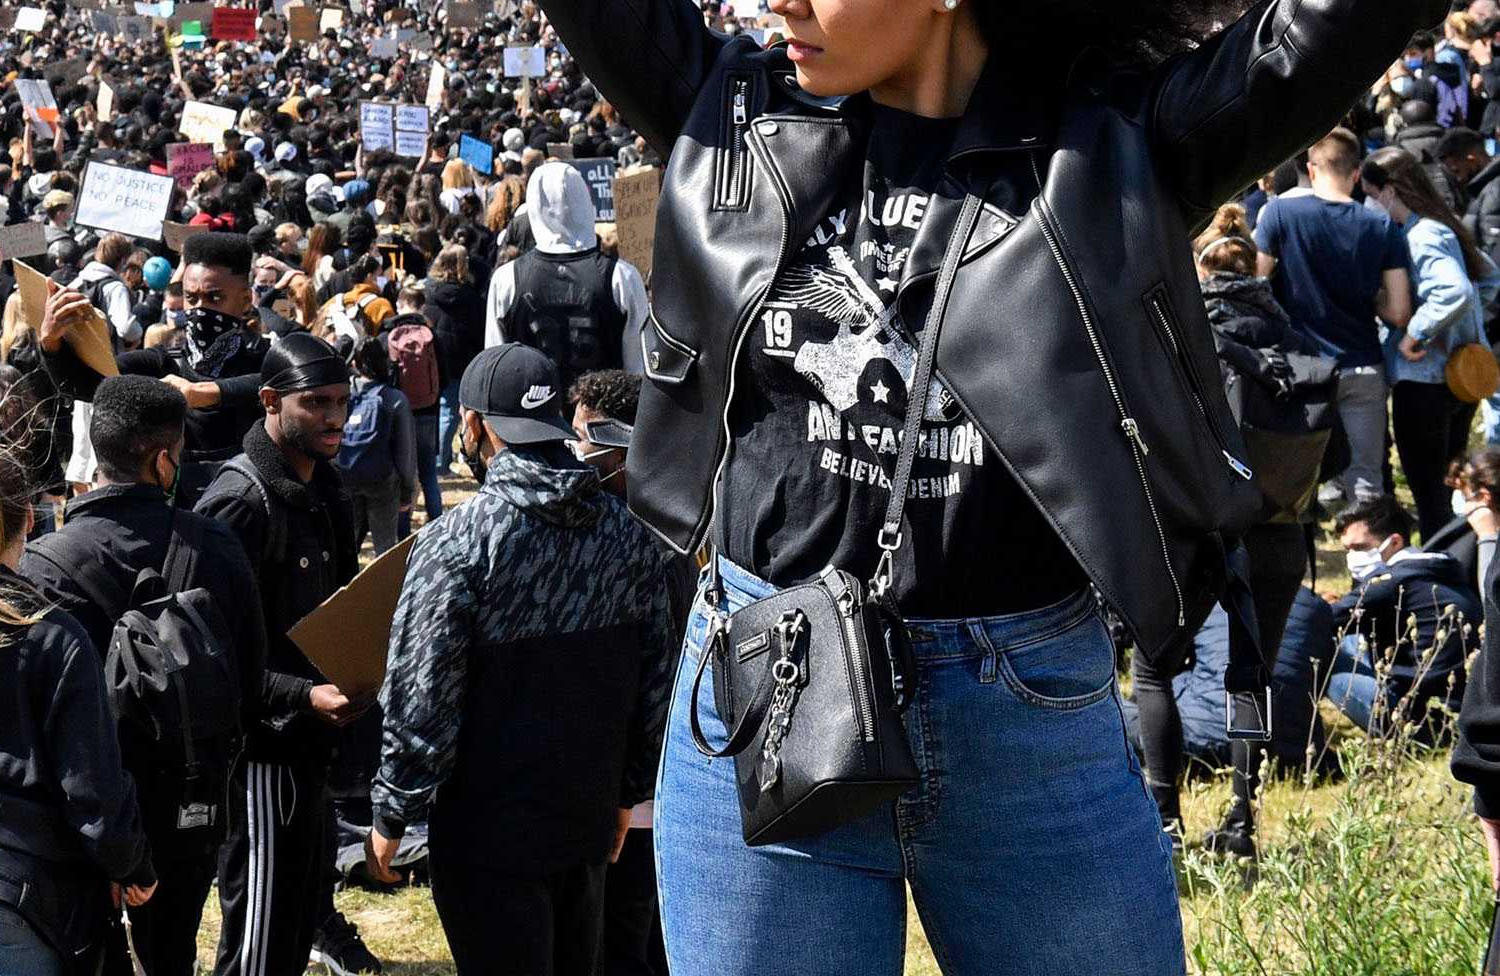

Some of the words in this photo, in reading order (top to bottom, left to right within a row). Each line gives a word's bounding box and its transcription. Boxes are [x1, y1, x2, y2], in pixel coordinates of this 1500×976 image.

[93, 170, 110, 183] NO
[115, 175, 166, 194] JUSTICE
[88, 189, 108, 202] NO
[115, 194, 157, 212] PEACE
[761, 309, 792, 348] 19
[528, 385, 551, 400] NIKE
[907, 472, 960, 499] DENIM
